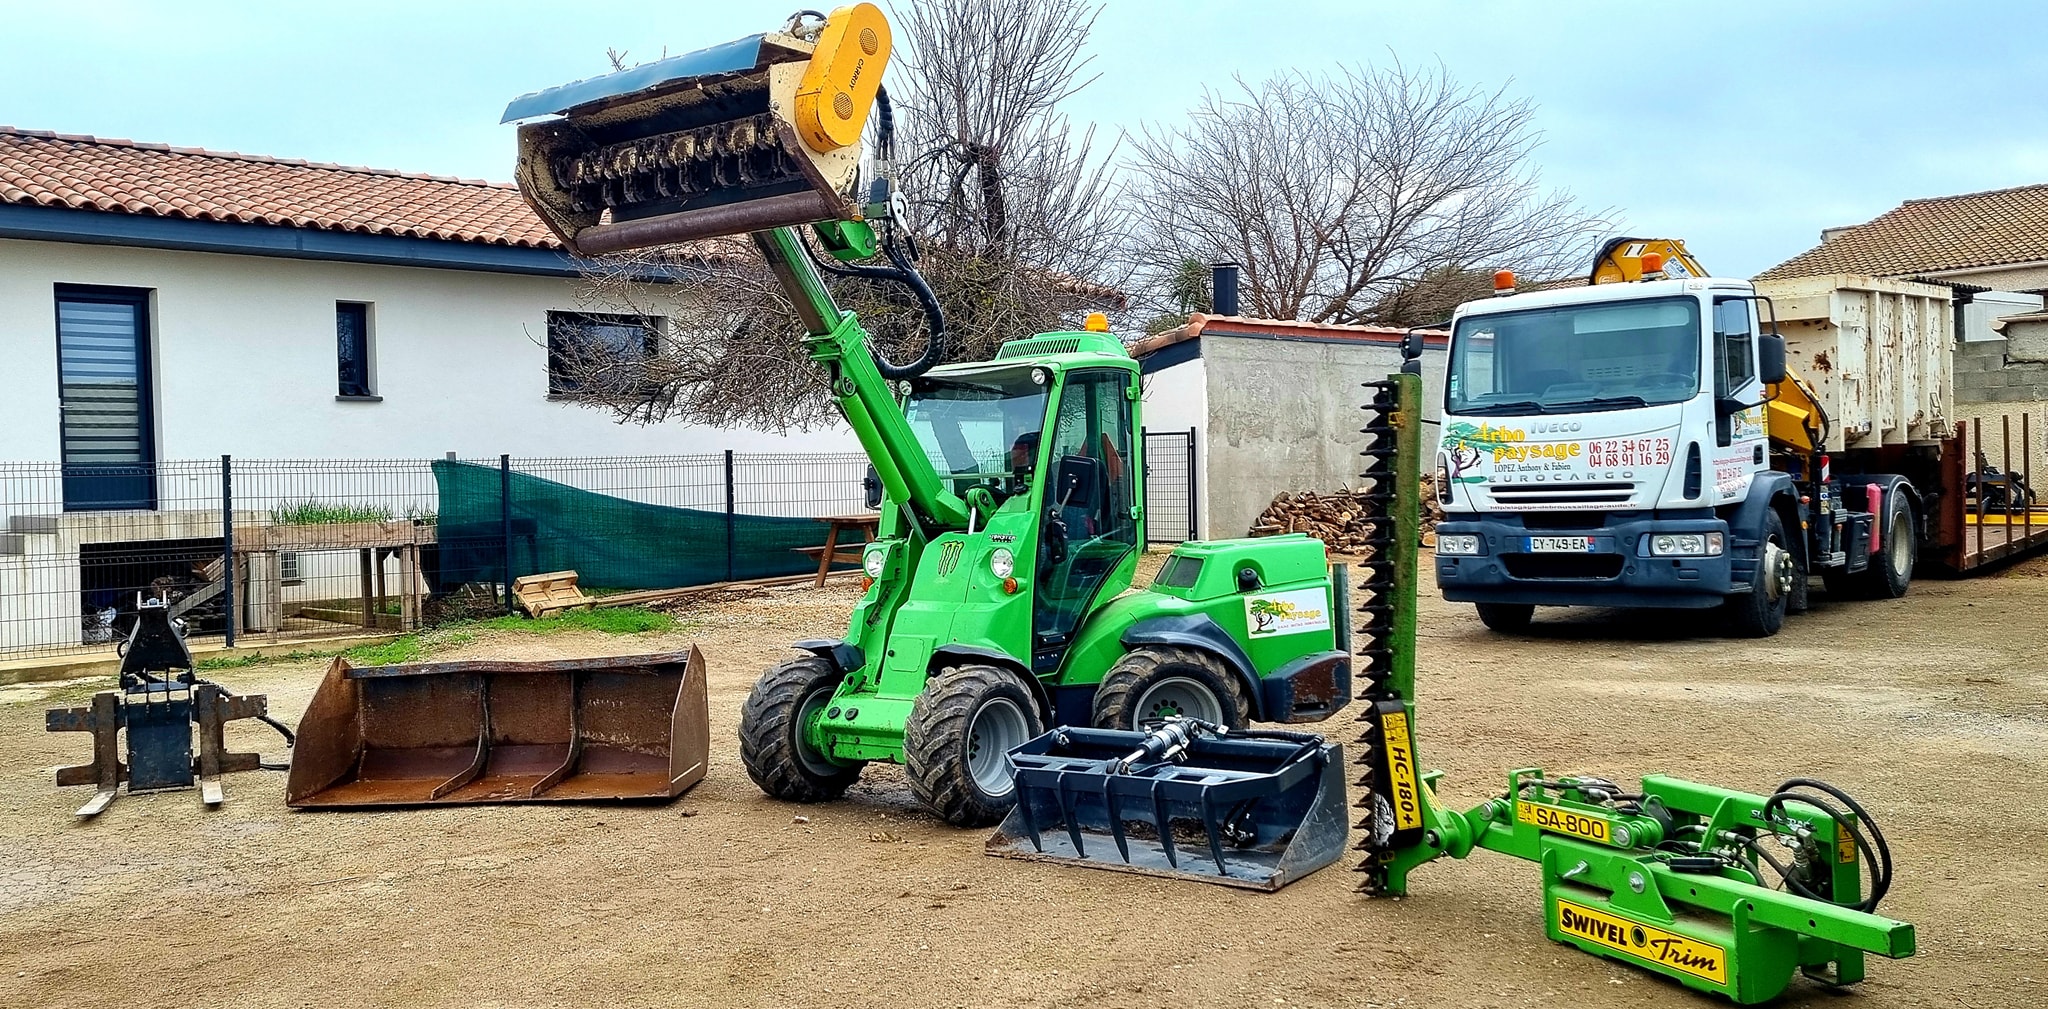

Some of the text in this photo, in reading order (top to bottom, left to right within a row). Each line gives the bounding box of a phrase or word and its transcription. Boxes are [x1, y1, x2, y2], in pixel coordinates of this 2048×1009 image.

[849, 58, 864, 91] CARROY
[1530, 421, 1582, 434] IVECO
[1493, 442, 1581, 464] paysage
[1588, 438, 1669, 454] 06 22 54 67 25
[1589, 451, 1669, 467] 04 68 91 16 29
[1494, 462, 1571, 473] LOPEZ Anthony & Fabien
[1488, 471, 1634, 483] EUROCARGO
[1533, 538, 1586, 550] CY-749-EA
[1280, 609, 1321, 622] paysage
[1392, 746, 1415, 825] HC-180+
[1536, 808, 1604, 839] SA-800
[1561, 907, 1717, 972] SWIVEL Trim
